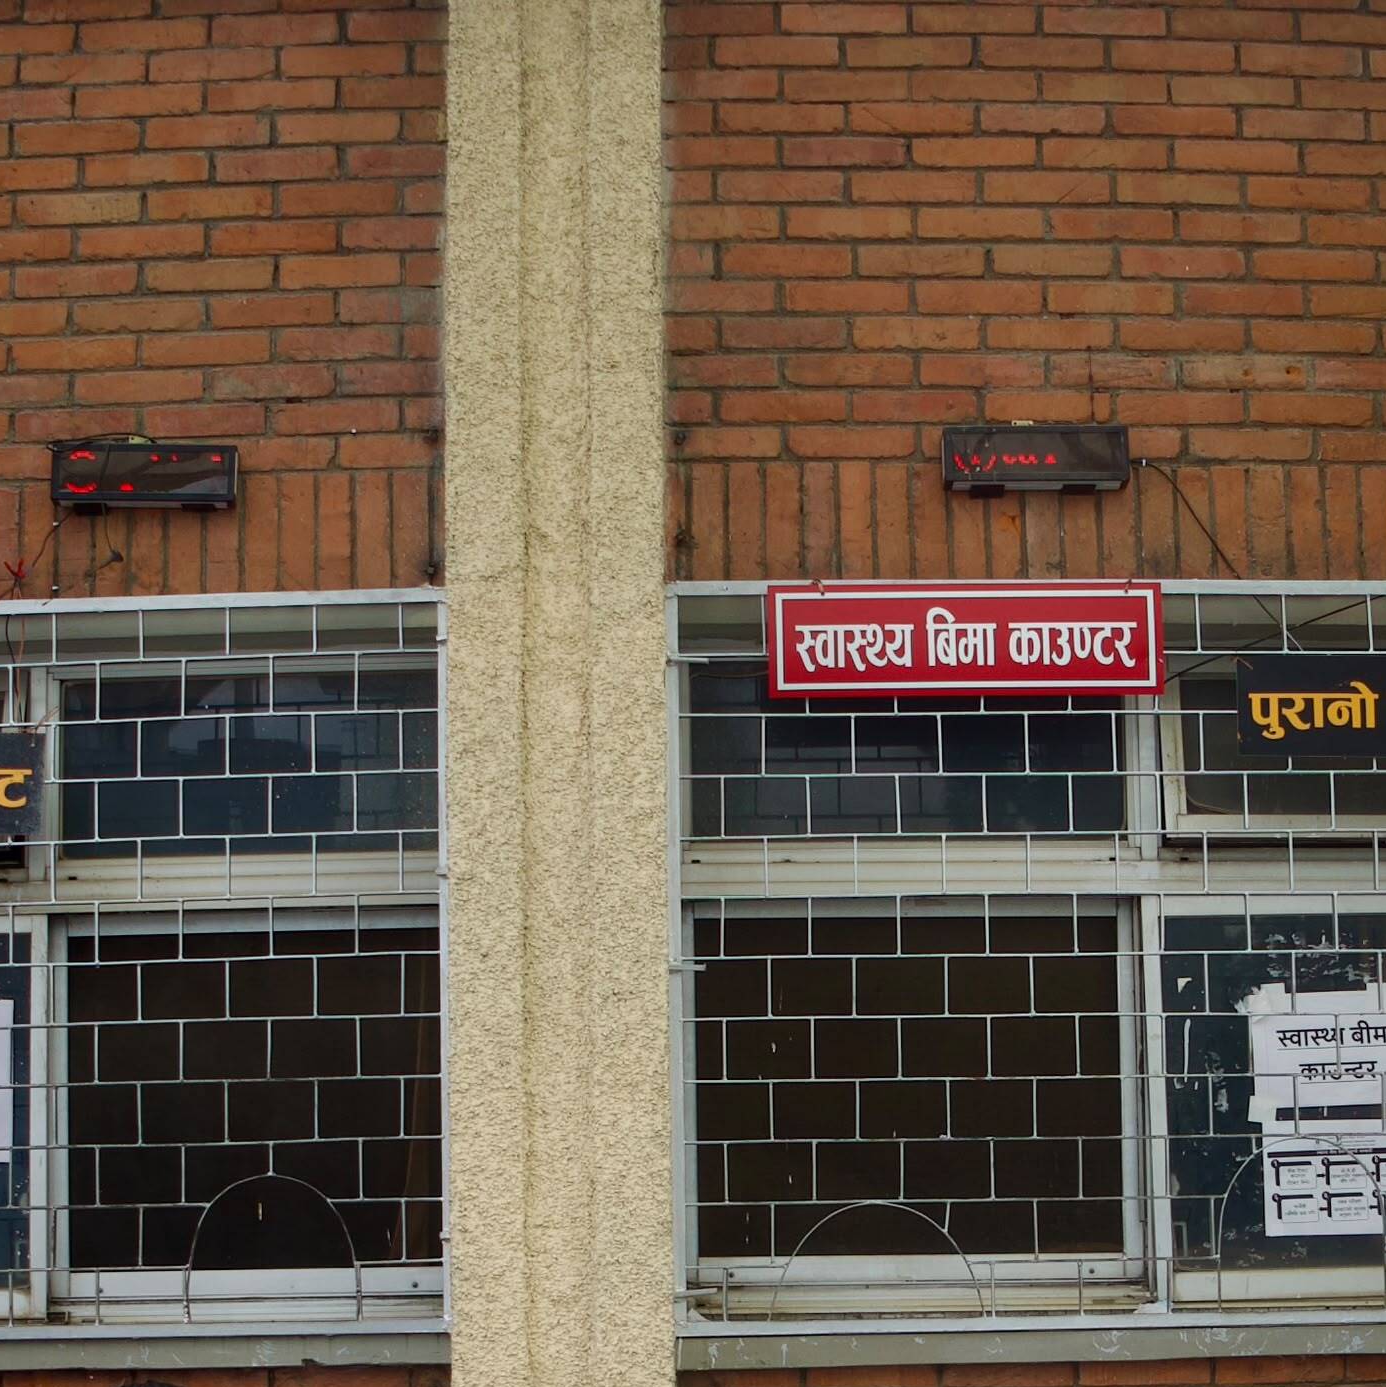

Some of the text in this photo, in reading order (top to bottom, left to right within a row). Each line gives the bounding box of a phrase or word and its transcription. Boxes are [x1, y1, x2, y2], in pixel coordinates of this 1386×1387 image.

[794, 606, 1138, 673] स्वास्थ्य बिमा काउण्टर
[1248, 681, 1379, 740] पुरानो
[1276, 1027, 1345, 1047] स्वास्थ्य
